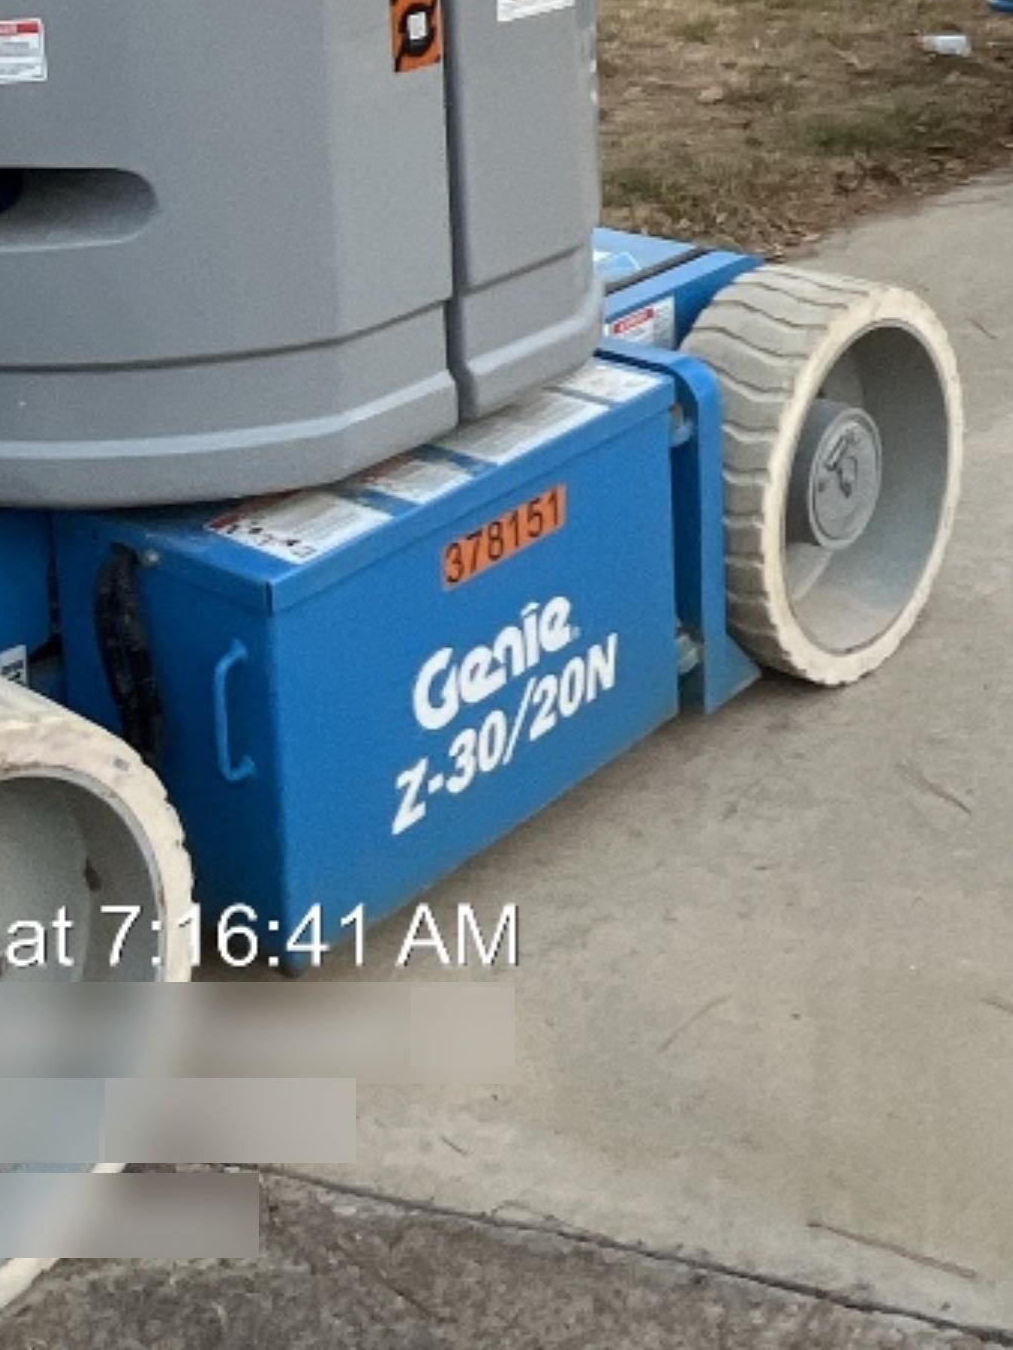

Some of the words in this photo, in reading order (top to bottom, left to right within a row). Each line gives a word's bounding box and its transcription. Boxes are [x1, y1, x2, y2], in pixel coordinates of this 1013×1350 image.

[445, 491, 560, 585] 378151
[412, 596, 573, 731] Genie
[391, 631, 619, 836] Z-30/20N
